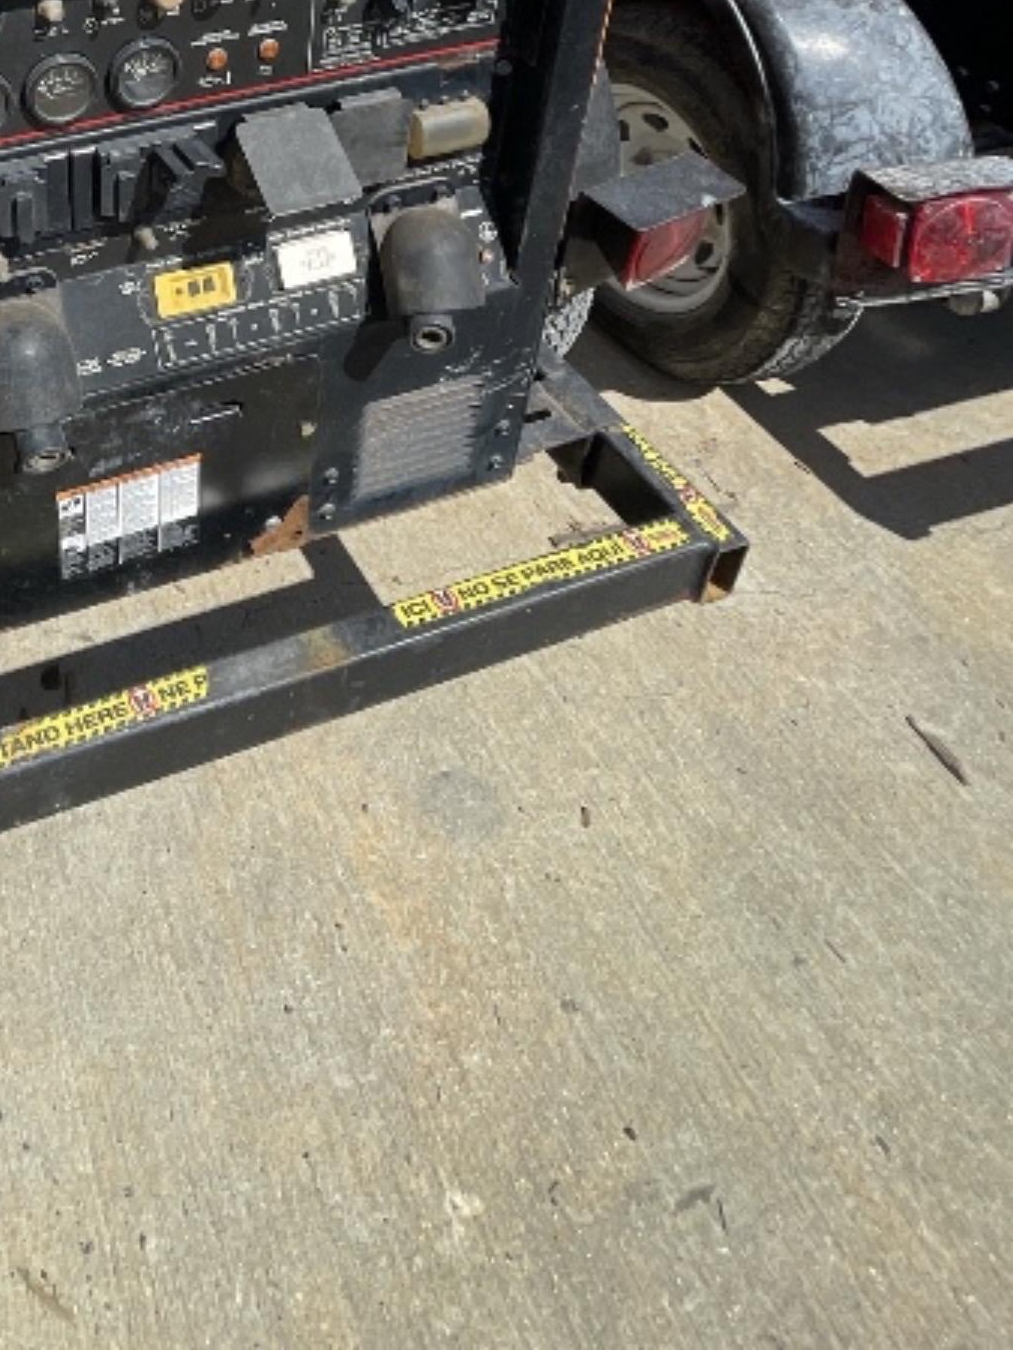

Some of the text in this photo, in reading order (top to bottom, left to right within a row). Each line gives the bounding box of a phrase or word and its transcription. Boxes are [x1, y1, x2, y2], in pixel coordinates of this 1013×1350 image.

[456, 580, 489, 601] NO
[523, 555, 575, 581] PARE
[65, 702, 129, 733] HERE
